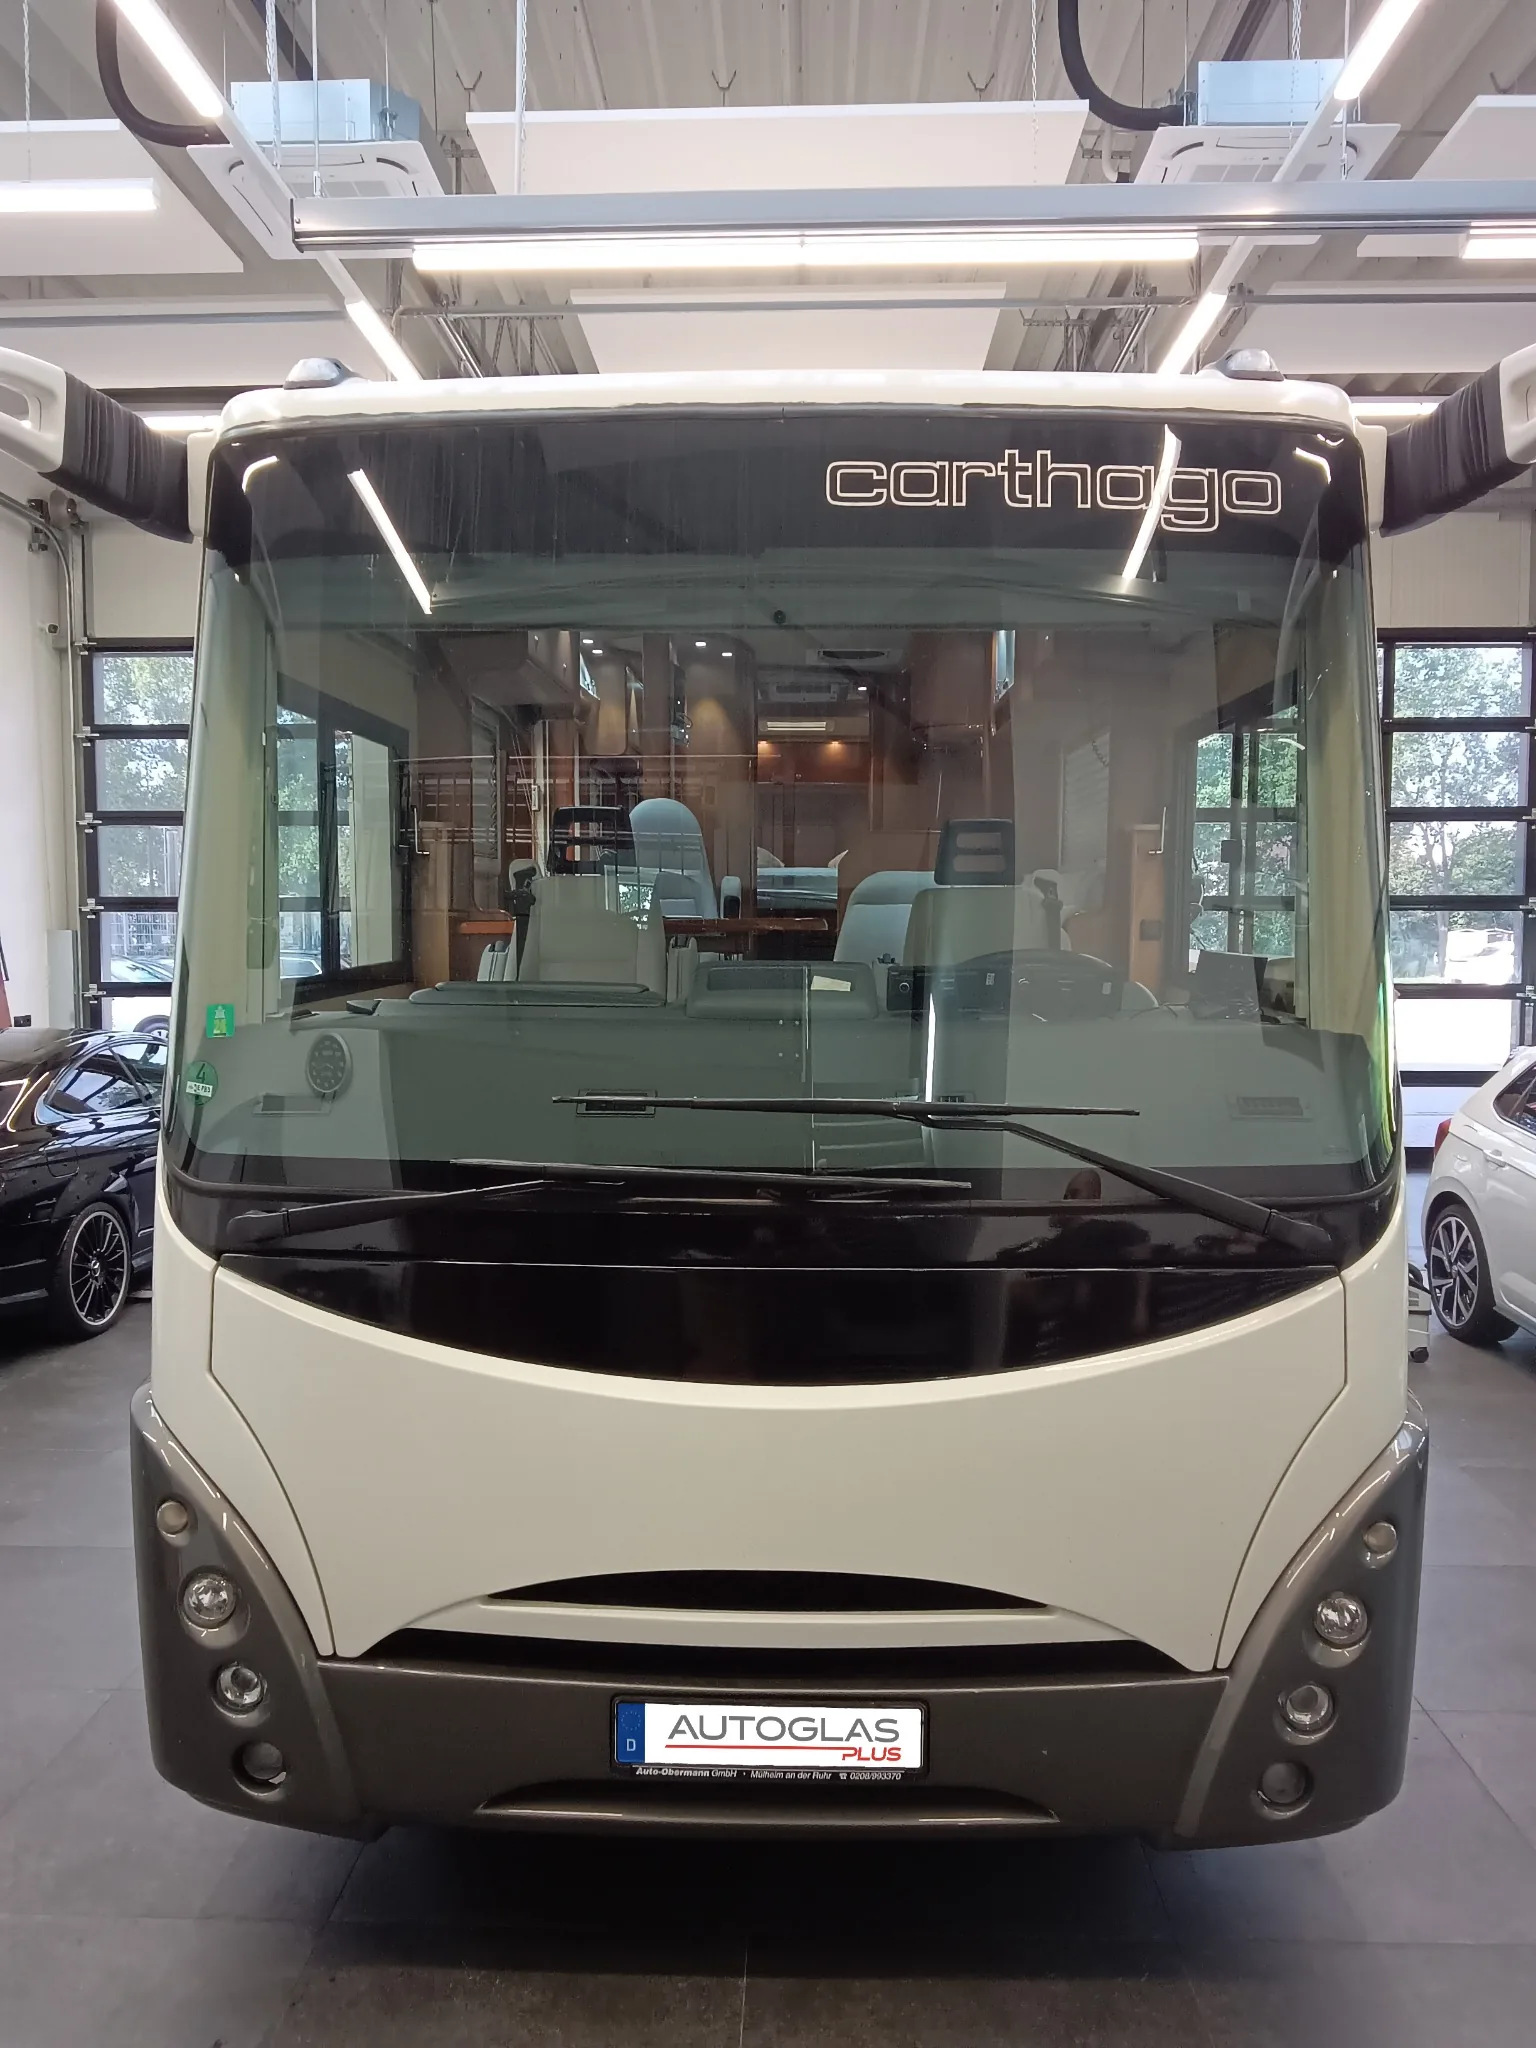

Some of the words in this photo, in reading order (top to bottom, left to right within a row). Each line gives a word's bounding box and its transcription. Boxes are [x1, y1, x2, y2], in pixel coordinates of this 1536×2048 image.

[826, 449, 1282, 533] carthago
[196, 1063, 206, 1084] 4
[668, 1714, 900, 1743] AUTOGLAS
[626, 1739, 636, 1752] D
[842, 1747, 902, 1761] PLUS
[635, 1767, 710, 1777] Auto-Obermann
[711, 1769, 738, 1778] GmbH
[750, 1770, 784, 1779] Mülheim
[797, 1771, 811, 1780] der
[812, 1771, 832, 1780] Ruhr
[849, 1772, 902, 1781] 0208/993370
